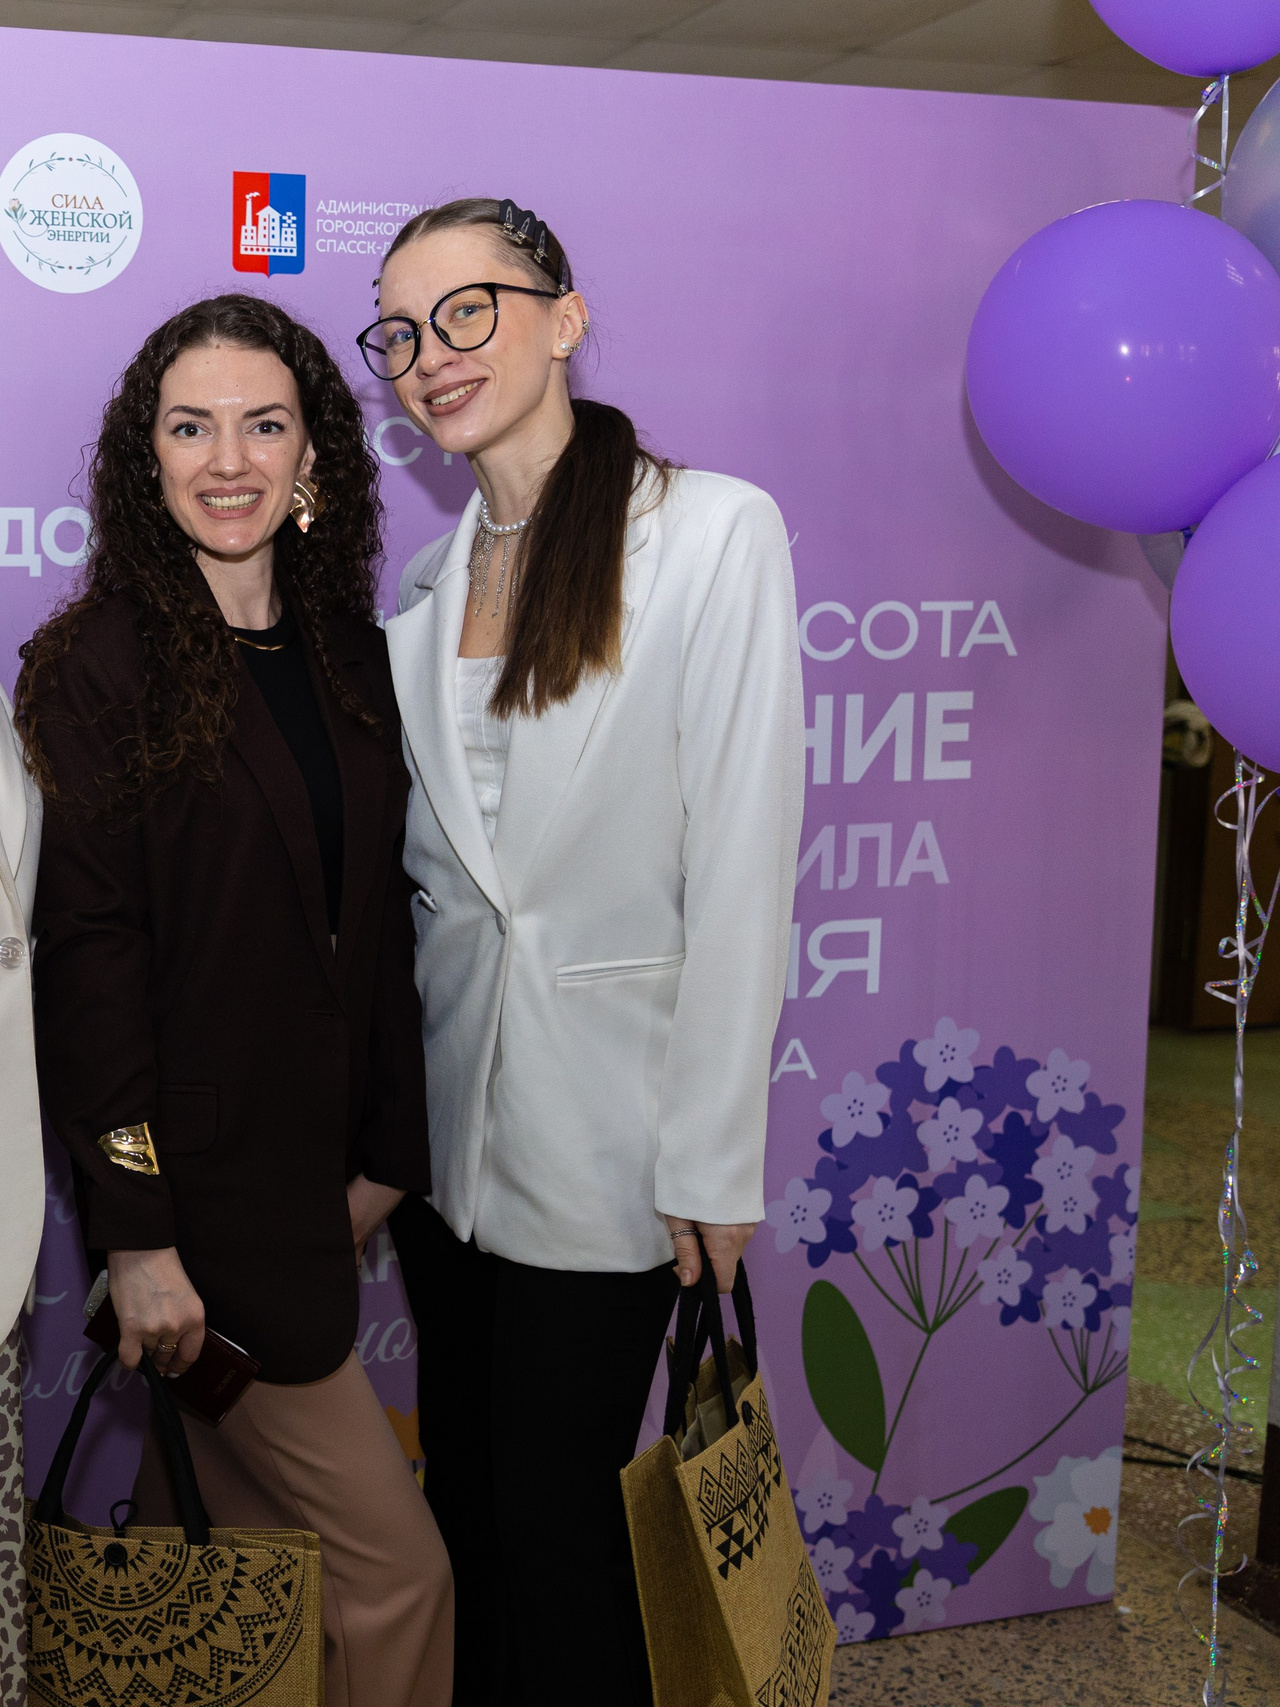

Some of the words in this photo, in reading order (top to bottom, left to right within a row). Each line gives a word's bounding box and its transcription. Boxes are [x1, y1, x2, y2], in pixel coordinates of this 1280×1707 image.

[51, 193, 105, 210] СИЛА
[316, 199, 432, 217] АДМИНИСТРА
[29, 210, 133, 230] ЖЕНСКОЙ
[316, 219, 404, 236] ГОРОДСКОГ
[47, 229, 110, 243] ЭНЕРГИИ
[797, 600, 1018, 661] СОТА
[794, 820, 950, 890] ИЛА
